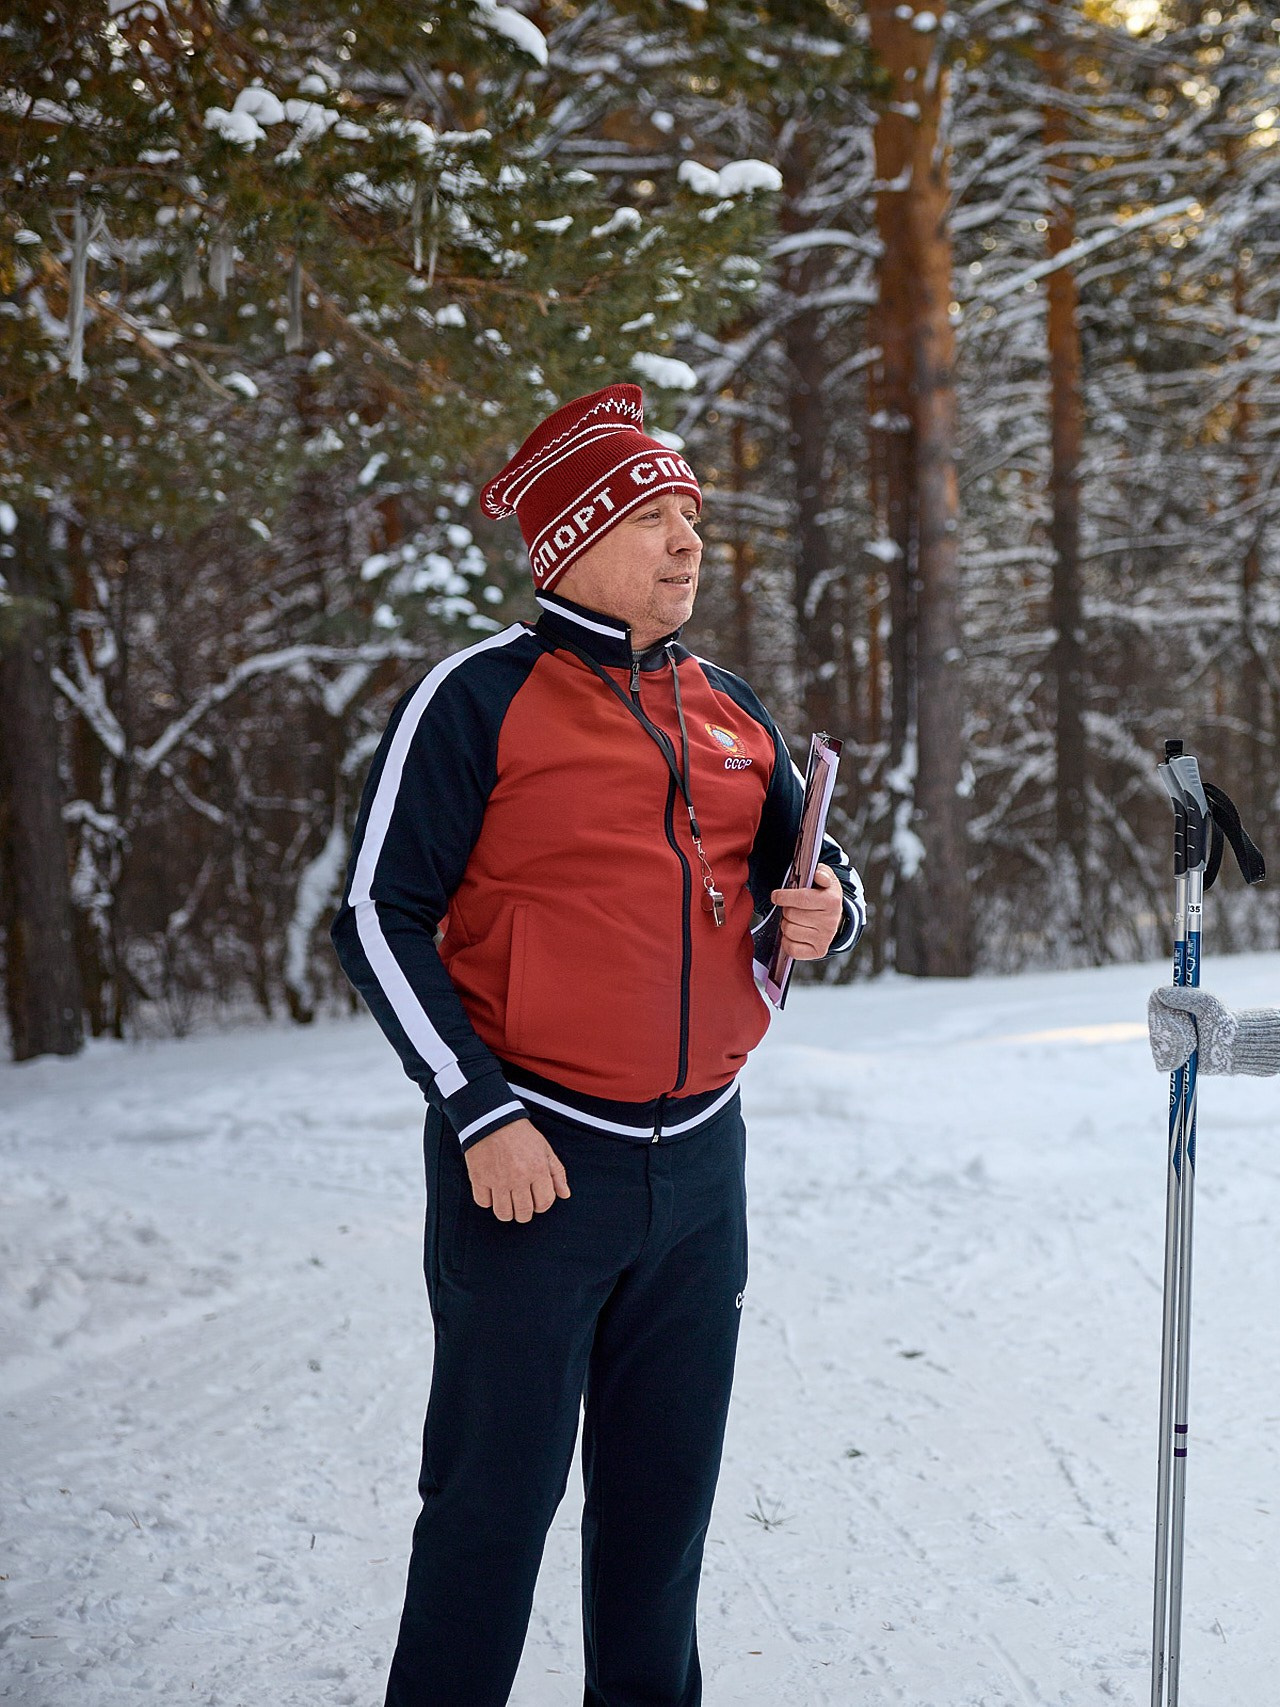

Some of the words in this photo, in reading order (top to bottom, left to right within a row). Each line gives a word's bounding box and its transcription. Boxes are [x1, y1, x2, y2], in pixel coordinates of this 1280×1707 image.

[533, 487, 615, 577] СПОРТ
[629, 457, 696, 485] СПО
[724, 757, 752, 770] СССР
